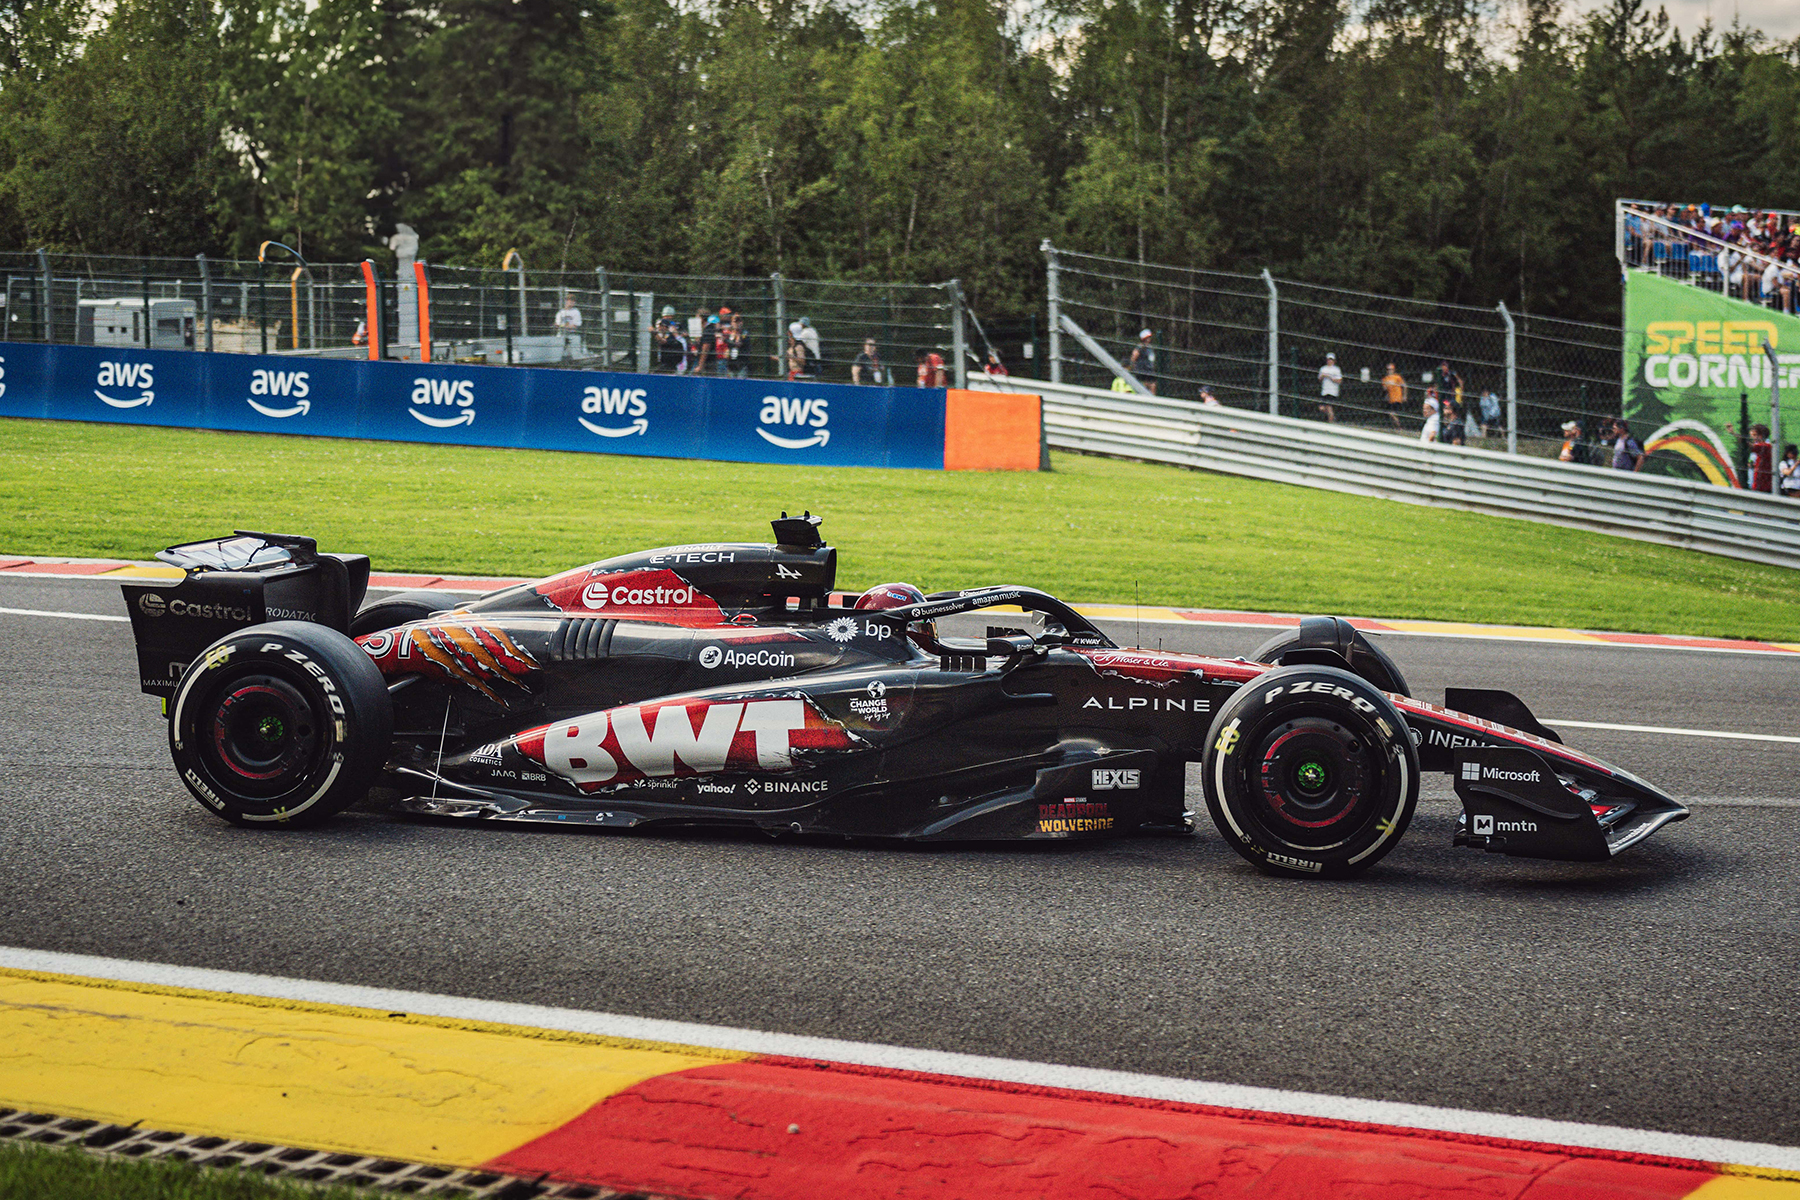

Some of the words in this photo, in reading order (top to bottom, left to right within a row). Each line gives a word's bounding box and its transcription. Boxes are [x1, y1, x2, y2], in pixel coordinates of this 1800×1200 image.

[1647, 321, 1778, 354] SPEED
[97, 361, 154, 389] aws
[250, 369, 309, 398] aws
[411, 377, 474, 407] aws
[581, 386, 647, 416] aws
[760, 396, 829, 427] aws
[611, 586, 693, 605] Castrol
[972, 595, 999, 606] amazon
[999, 590, 1021, 600] music
[921, 602, 965, 615] businessolver
[865, 620, 892, 641] bp
[724, 649, 795, 668] ApeCoin
[143, 679, 178, 688] MAXIMU
[260, 643, 283, 652] P
[284, 649, 346, 716] ZERO
[850, 699, 887, 708] CHANGE
[1082, 696, 1210, 712] ALPINE
[1265, 686, 1284, 705] P
[1289, 681, 1376, 714] ZERO
[858, 706, 888, 714] WORLD
[544, 699, 805, 784] BWT
[472, 743, 503, 758] ADA
[469, 756, 502, 766] COSMETICS
[530, 773, 547, 782] BRB
[1093, 769, 1141, 789] HEXIS
[1483, 767, 1540, 783] Microsoft
[647, 779, 678, 790] sprinklr
[697, 783, 737, 795] yahoo!
[764, 780, 828, 793] BINANCE
[1039, 803, 1112, 818] DEADPOOL
[1039, 818, 1114, 832] WOLVERINE
[1497, 820, 1539, 832] mntn
